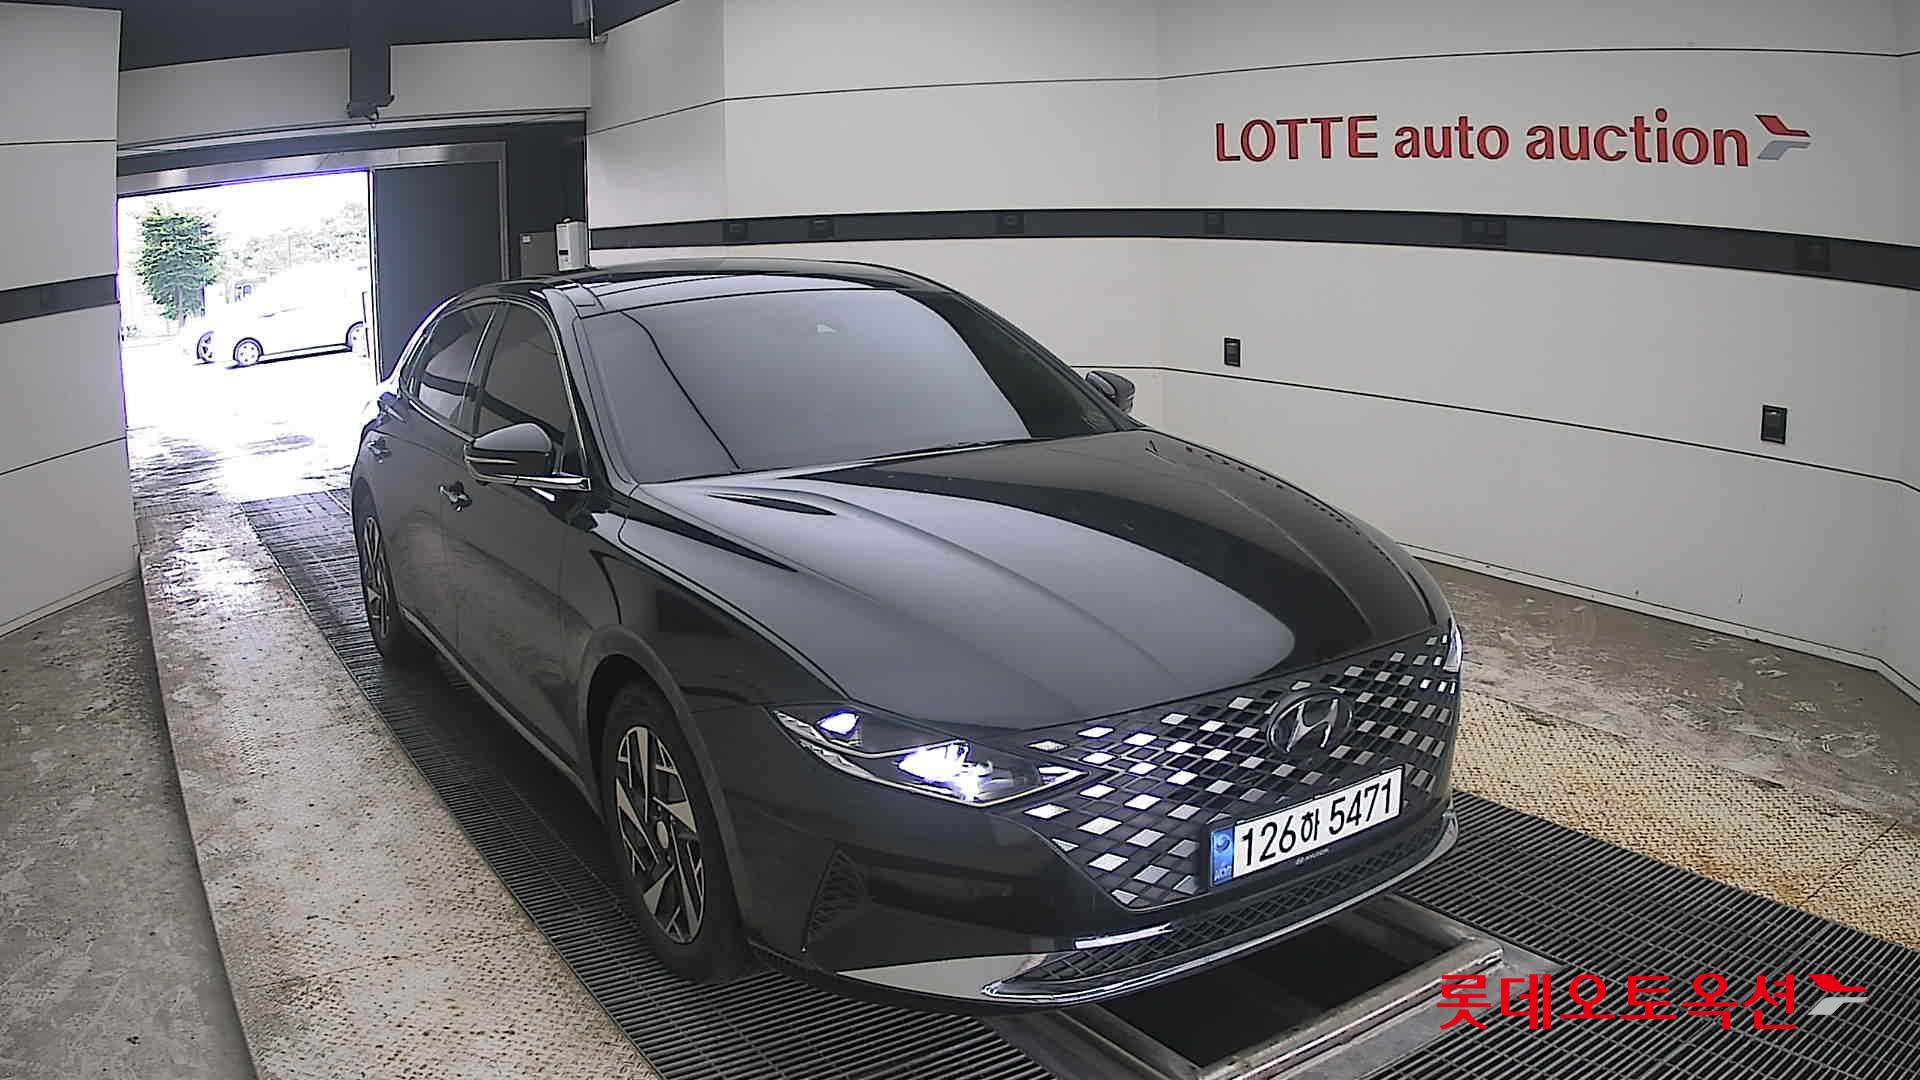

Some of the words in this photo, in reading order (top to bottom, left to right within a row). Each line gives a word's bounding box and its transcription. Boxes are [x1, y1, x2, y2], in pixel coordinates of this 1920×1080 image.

[1216, 115, 1378, 162] LOTTE
[1394, 116, 1509, 161] auto
[1526, 108, 1749, 167] auction
[1241, 808, 1321, 867] 126하
[1328, 778, 1393, 836] 5471
